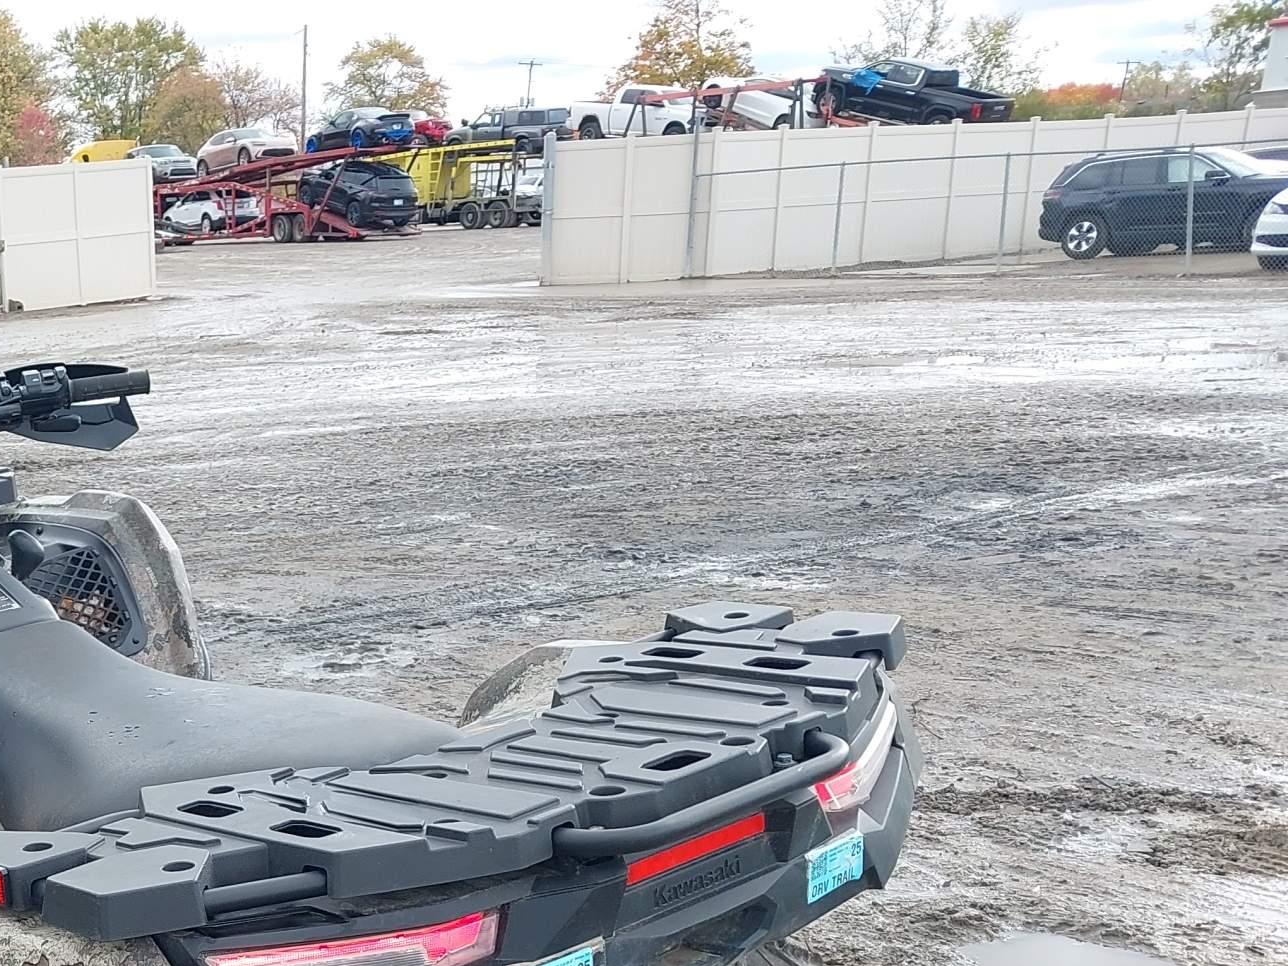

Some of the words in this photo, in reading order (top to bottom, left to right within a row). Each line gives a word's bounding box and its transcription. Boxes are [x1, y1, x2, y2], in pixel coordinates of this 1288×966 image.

[851, 841, 862, 857] 25
[653, 855, 741, 907] Kawasaki
[812, 879, 829, 898] ORV
[831, 866, 855, 888] TRAIL
